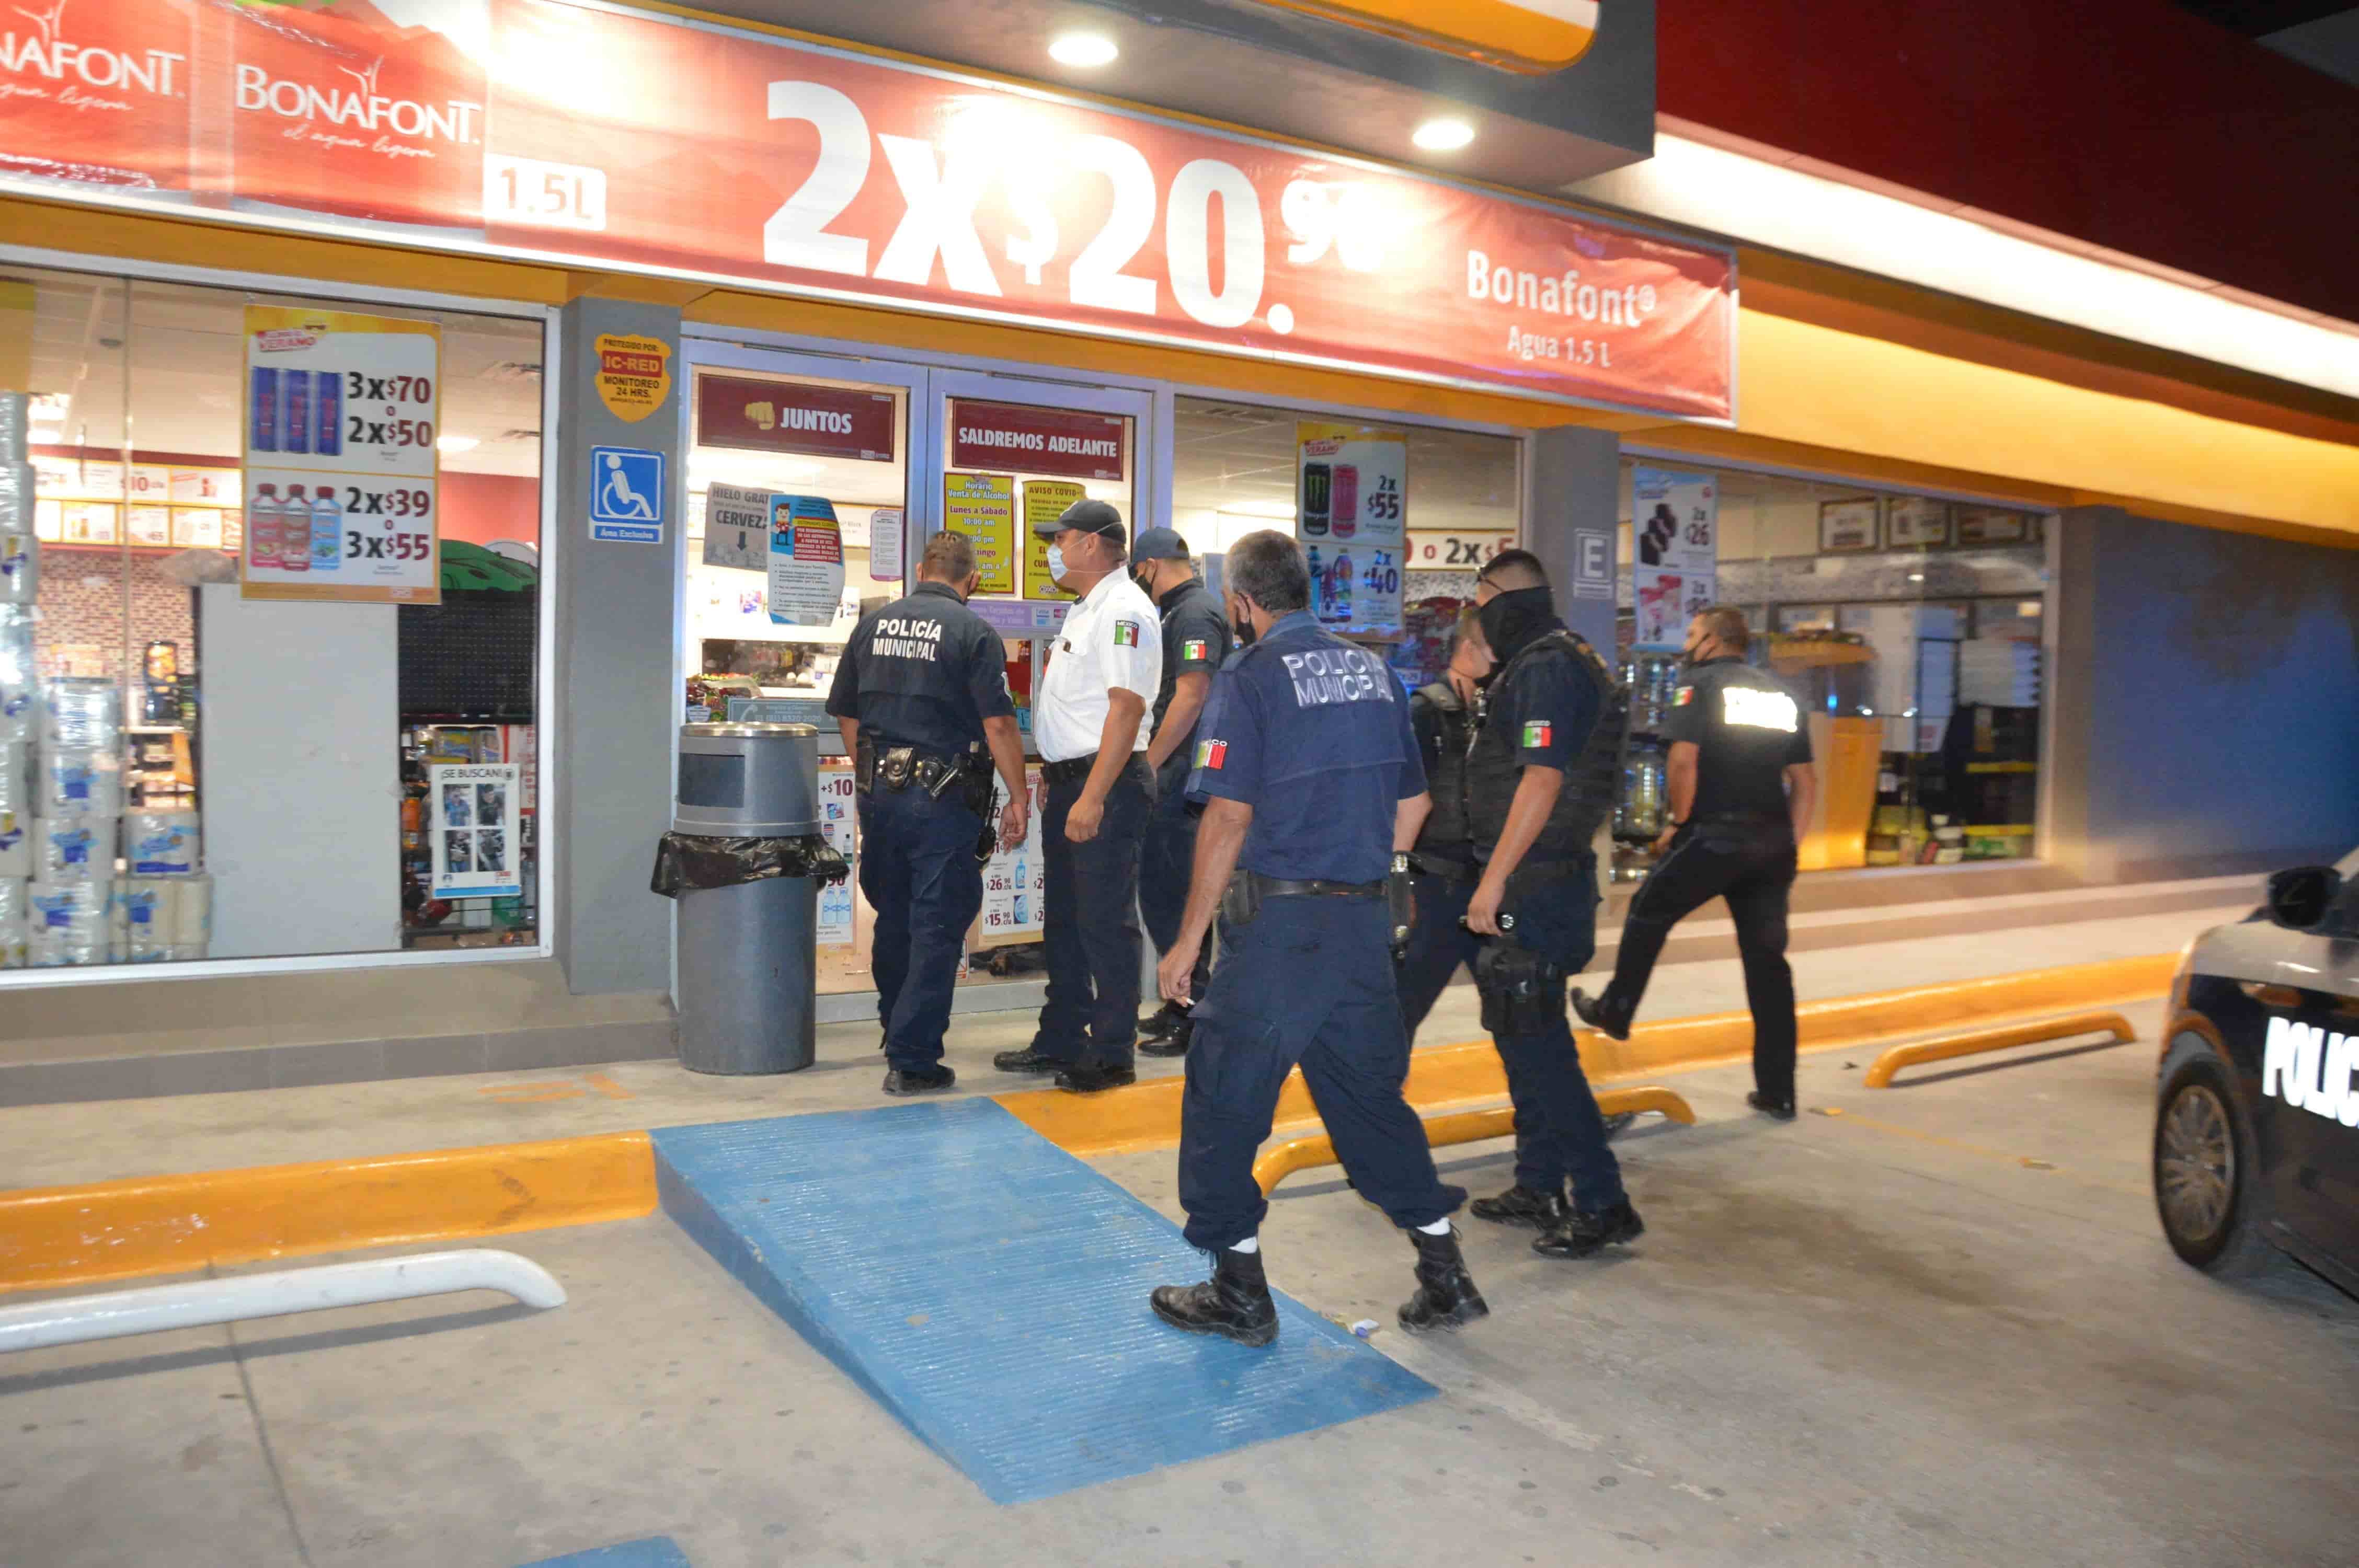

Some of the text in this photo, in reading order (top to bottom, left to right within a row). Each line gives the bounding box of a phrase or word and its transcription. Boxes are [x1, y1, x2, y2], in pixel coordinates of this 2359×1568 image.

[236, 63, 481, 144] BONAFONT
[1508, 325, 1559, 361] Agua
[1565, 337, 1594, 364] 1.5
[605, 355, 660, 373] IC-RED
[604, 376, 660, 389] MONITOREO
[616, 386, 628, 396] 24
[781, 407, 853, 434] JUNTOS
[959, 426, 1117, 457] SALDREMOS ADELANTE
[713, 487, 741, 501] HIELO
[965, 480, 993, 490] Horario
[1029, 486, 1052, 494] AVISO
[948, 489, 1010, 500] Venta de Alcohol
[950, 505, 971, 514] Lunes
[1584, 538, 1605, 577] E
[875, 618, 942, 642] POLICÍA
[872, 638, 936, 662] MUNICIPAL
